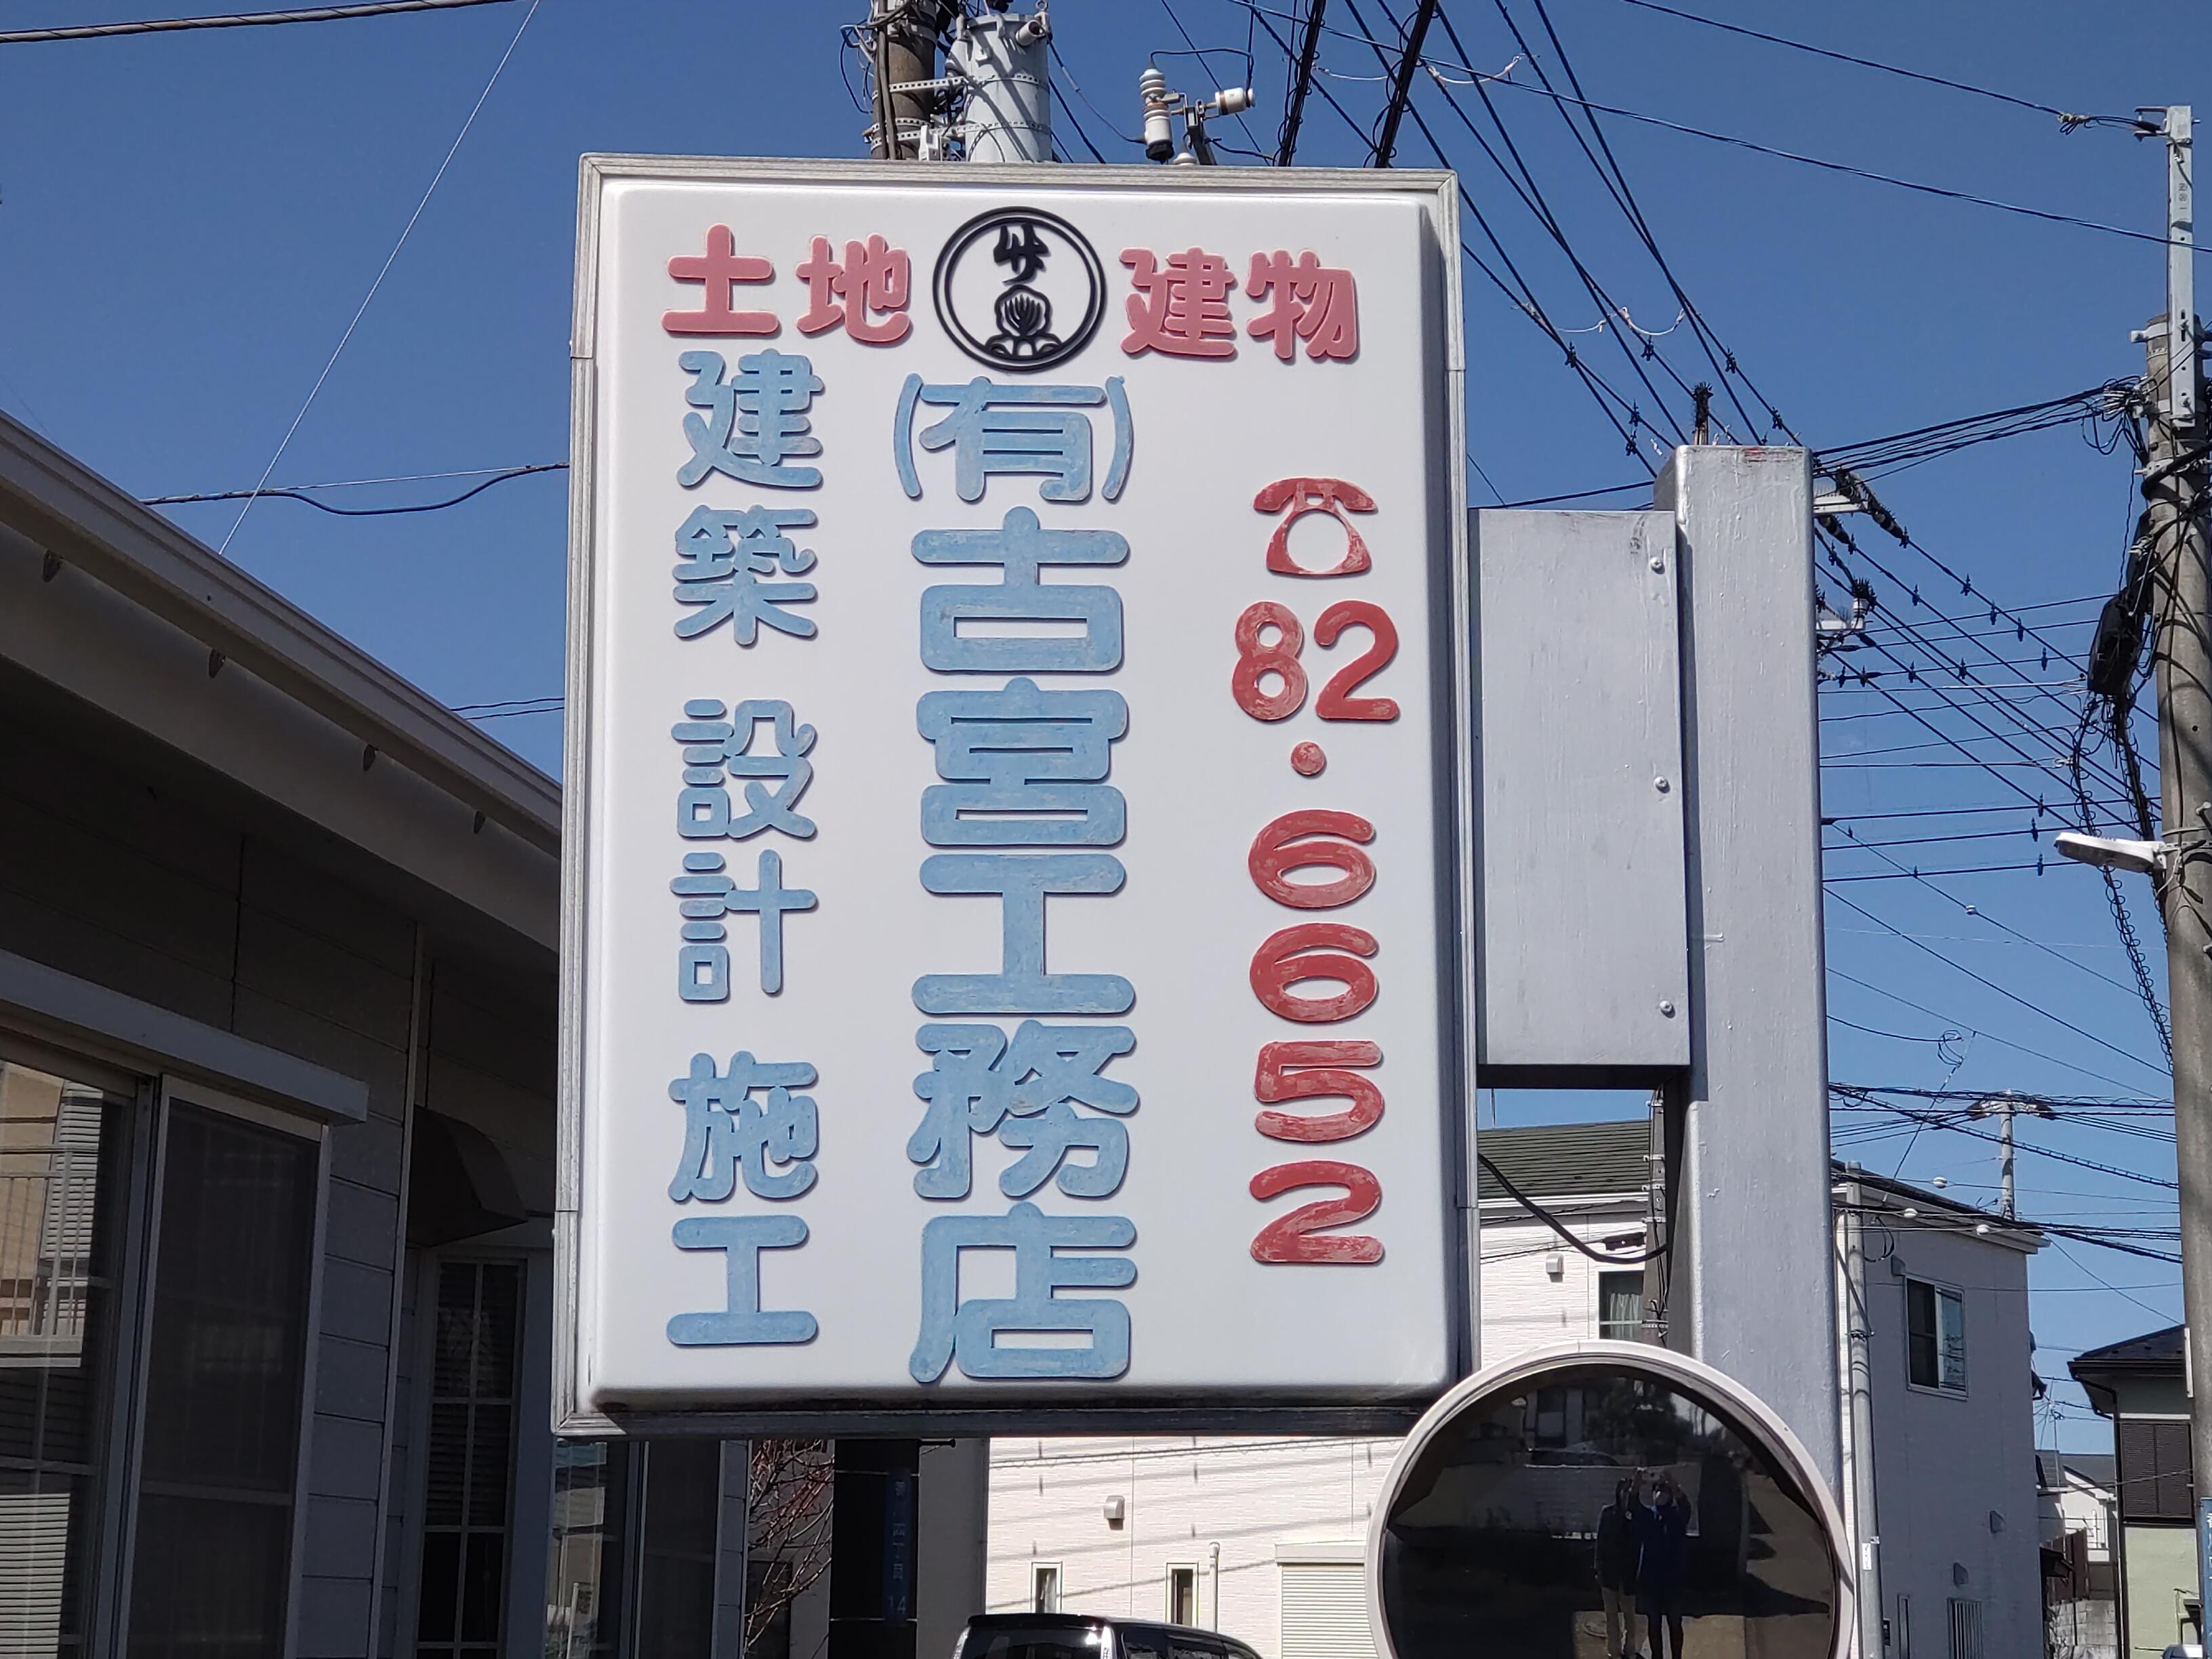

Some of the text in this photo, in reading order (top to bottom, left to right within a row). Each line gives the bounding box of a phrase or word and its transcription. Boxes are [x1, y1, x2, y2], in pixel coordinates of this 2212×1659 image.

[661, 223, 1359, 361] 土地 建物
[666, 348, 824, 1346] 建築 設計 施工
